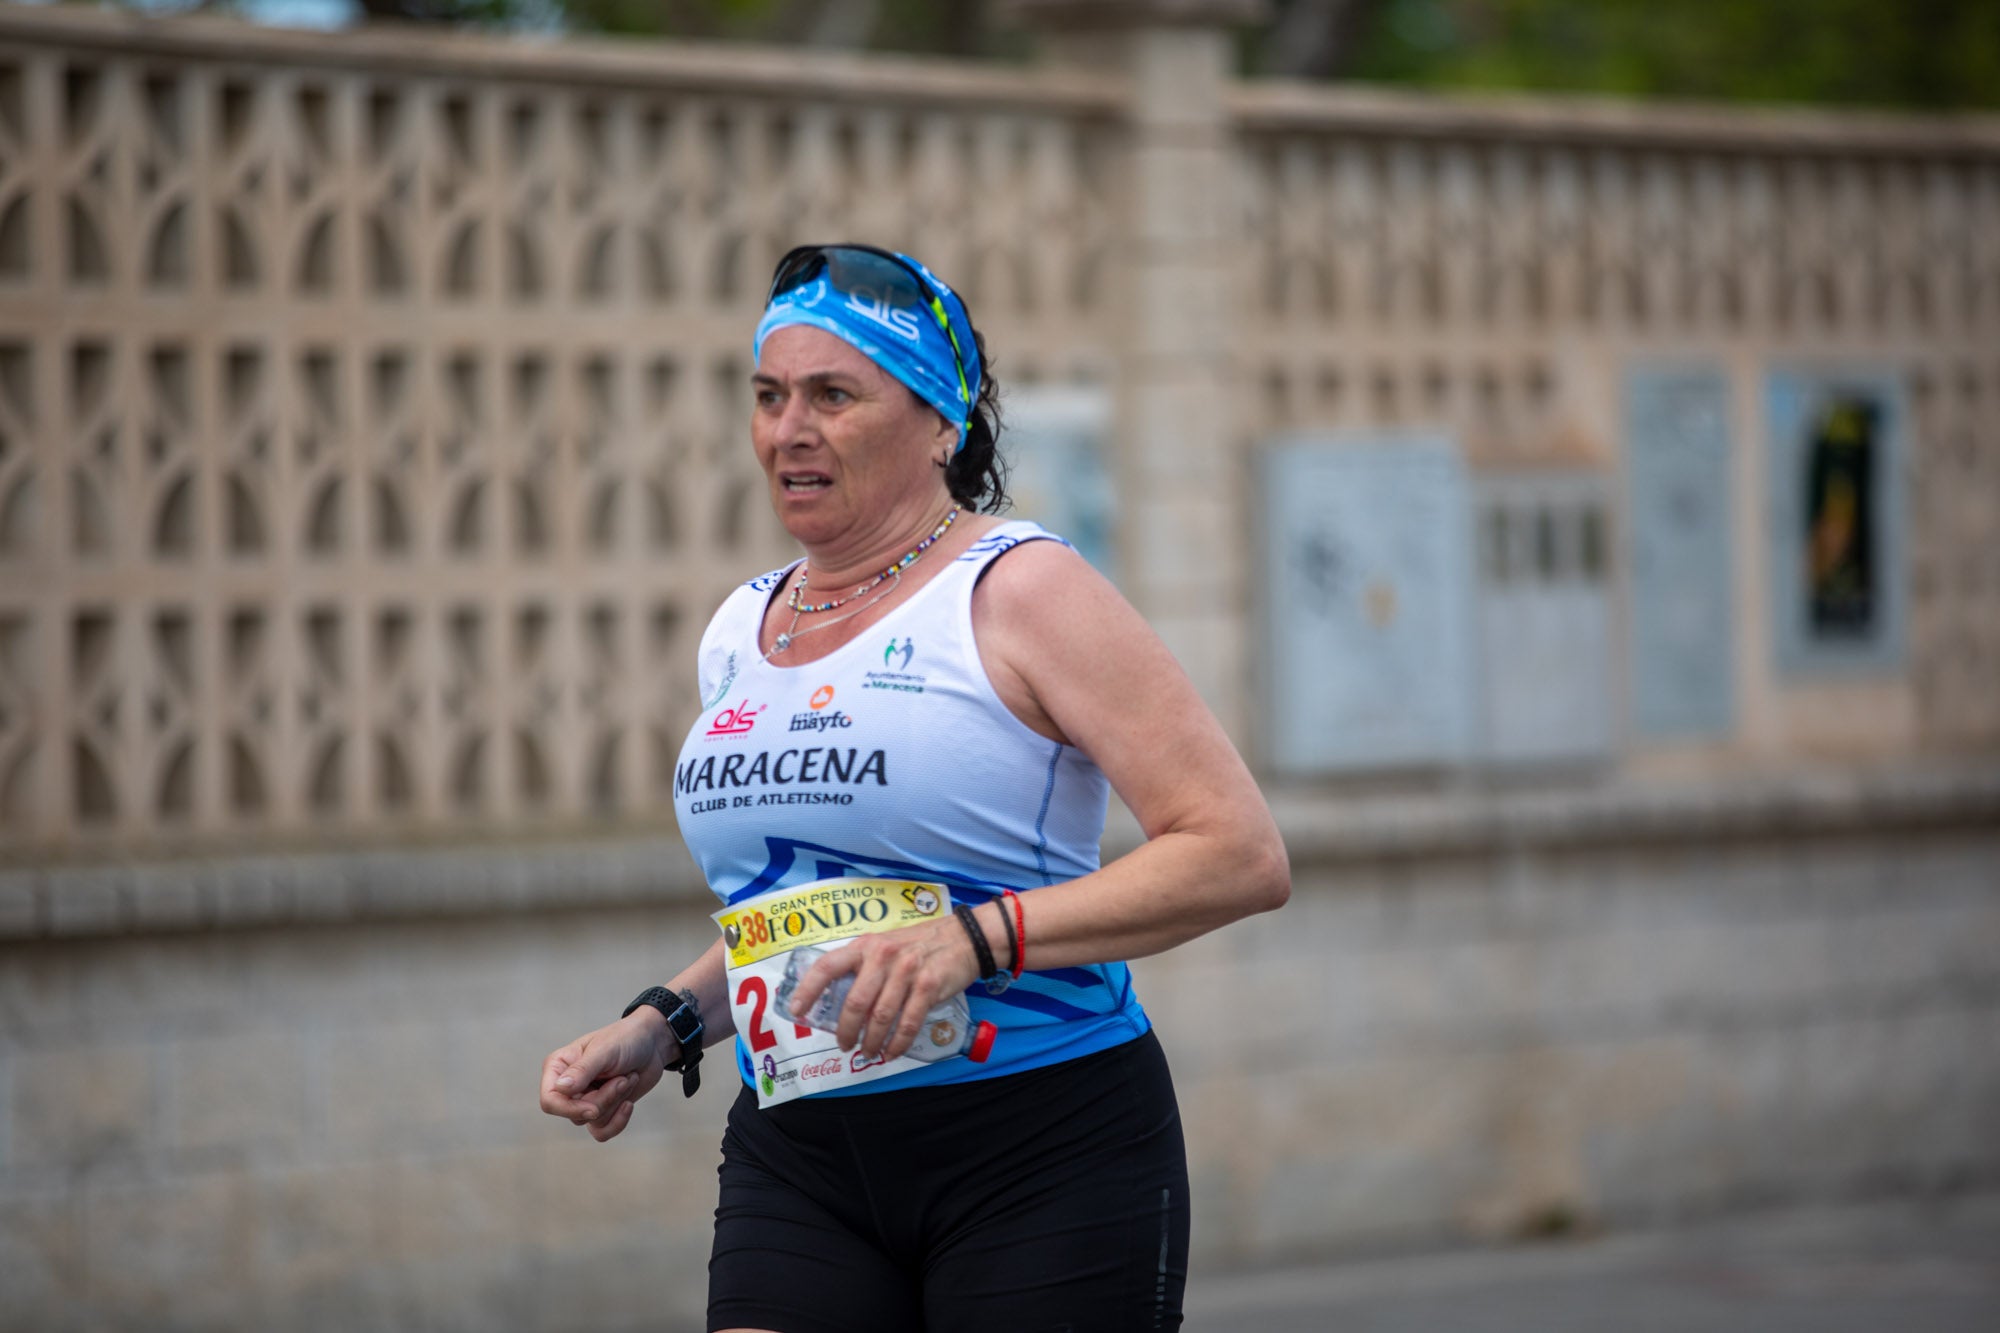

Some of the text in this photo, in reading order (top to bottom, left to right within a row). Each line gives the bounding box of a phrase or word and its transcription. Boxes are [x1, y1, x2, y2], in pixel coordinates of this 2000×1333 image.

[872, 680, 924, 693] Maracena
[675, 748, 888, 799] MARACENA
[691, 792, 854, 814] CLUB DE ATLETISMO
[770, 896, 807, 916] GRAN
[810, 886, 874, 905] PREMIO
[741, 911, 769, 948] 38
[766, 898, 889, 943] FONDO
[801, 1057, 842, 1081] Coca-Cola
